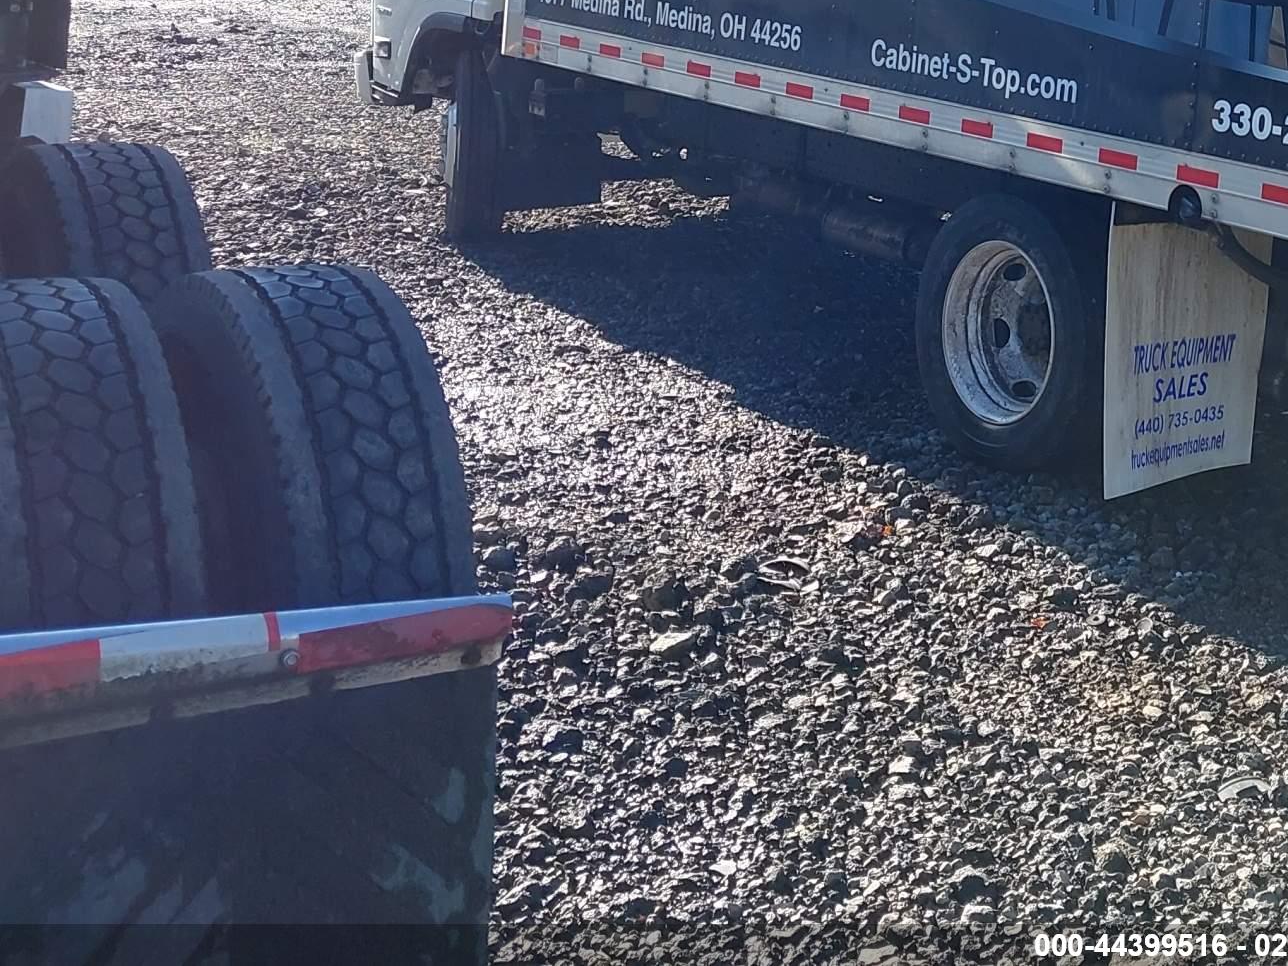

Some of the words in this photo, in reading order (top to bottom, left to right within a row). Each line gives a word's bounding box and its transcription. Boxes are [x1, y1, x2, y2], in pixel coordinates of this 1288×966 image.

[655, 1, 716, 41] Medina,
[720, 12, 747, 42] OH
[750, 18, 802, 52] 44256
[871, 38, 1079, 105] Cabinet-S-Top.com
[1133, 340, 1170, 376] TRUCK
[1170, 333, 1237, 370] EQUIPMENT
[1152, 372, 1209, 404] SALES
[1134, 415, 1165, 440] (440)
[1168, 404, 1225, 431] 735-0435
[1130, 432, 1226, 471] truckequipmentsales.net
